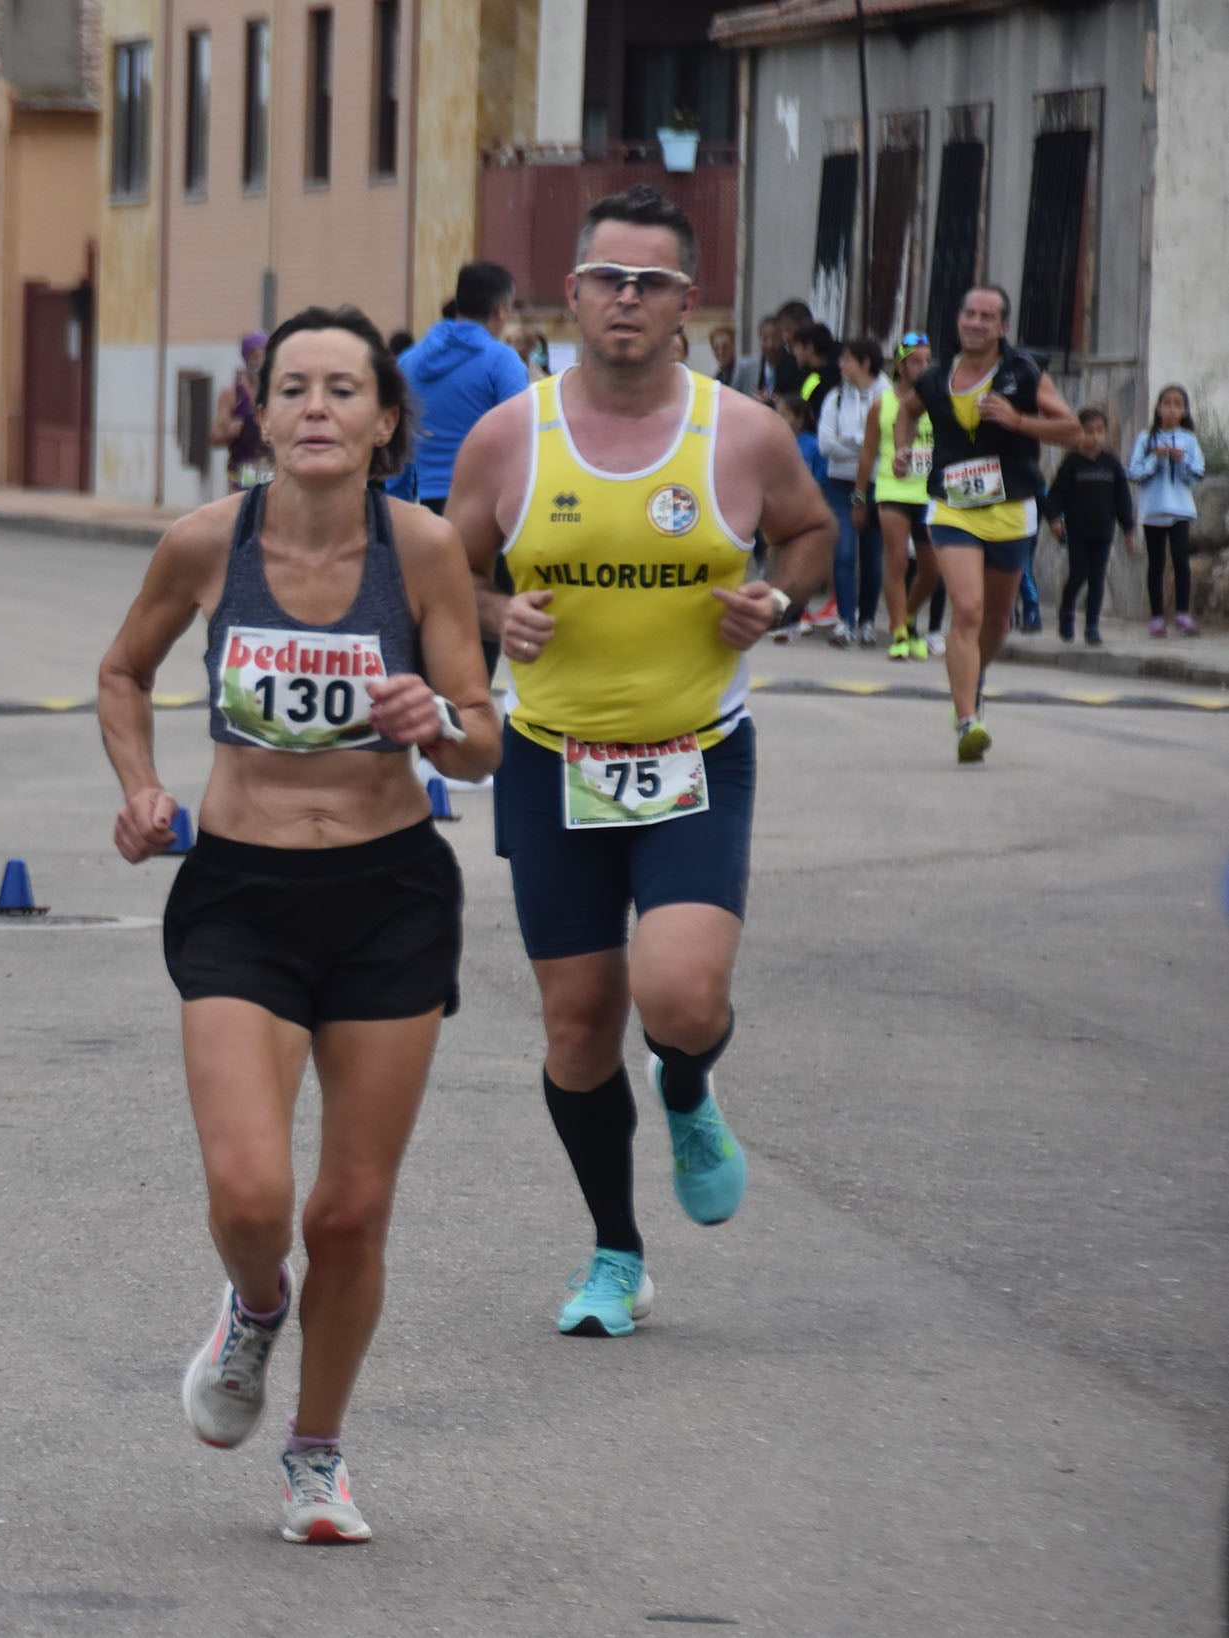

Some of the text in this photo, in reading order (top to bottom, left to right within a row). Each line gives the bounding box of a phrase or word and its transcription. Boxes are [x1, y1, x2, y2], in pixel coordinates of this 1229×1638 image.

[534, 562, 710, 589] VILLORUELA
[227, 635, 385, 677] bedunia
[255, 675, 356, 726] 130
[605, 760, 662, 802] 75
